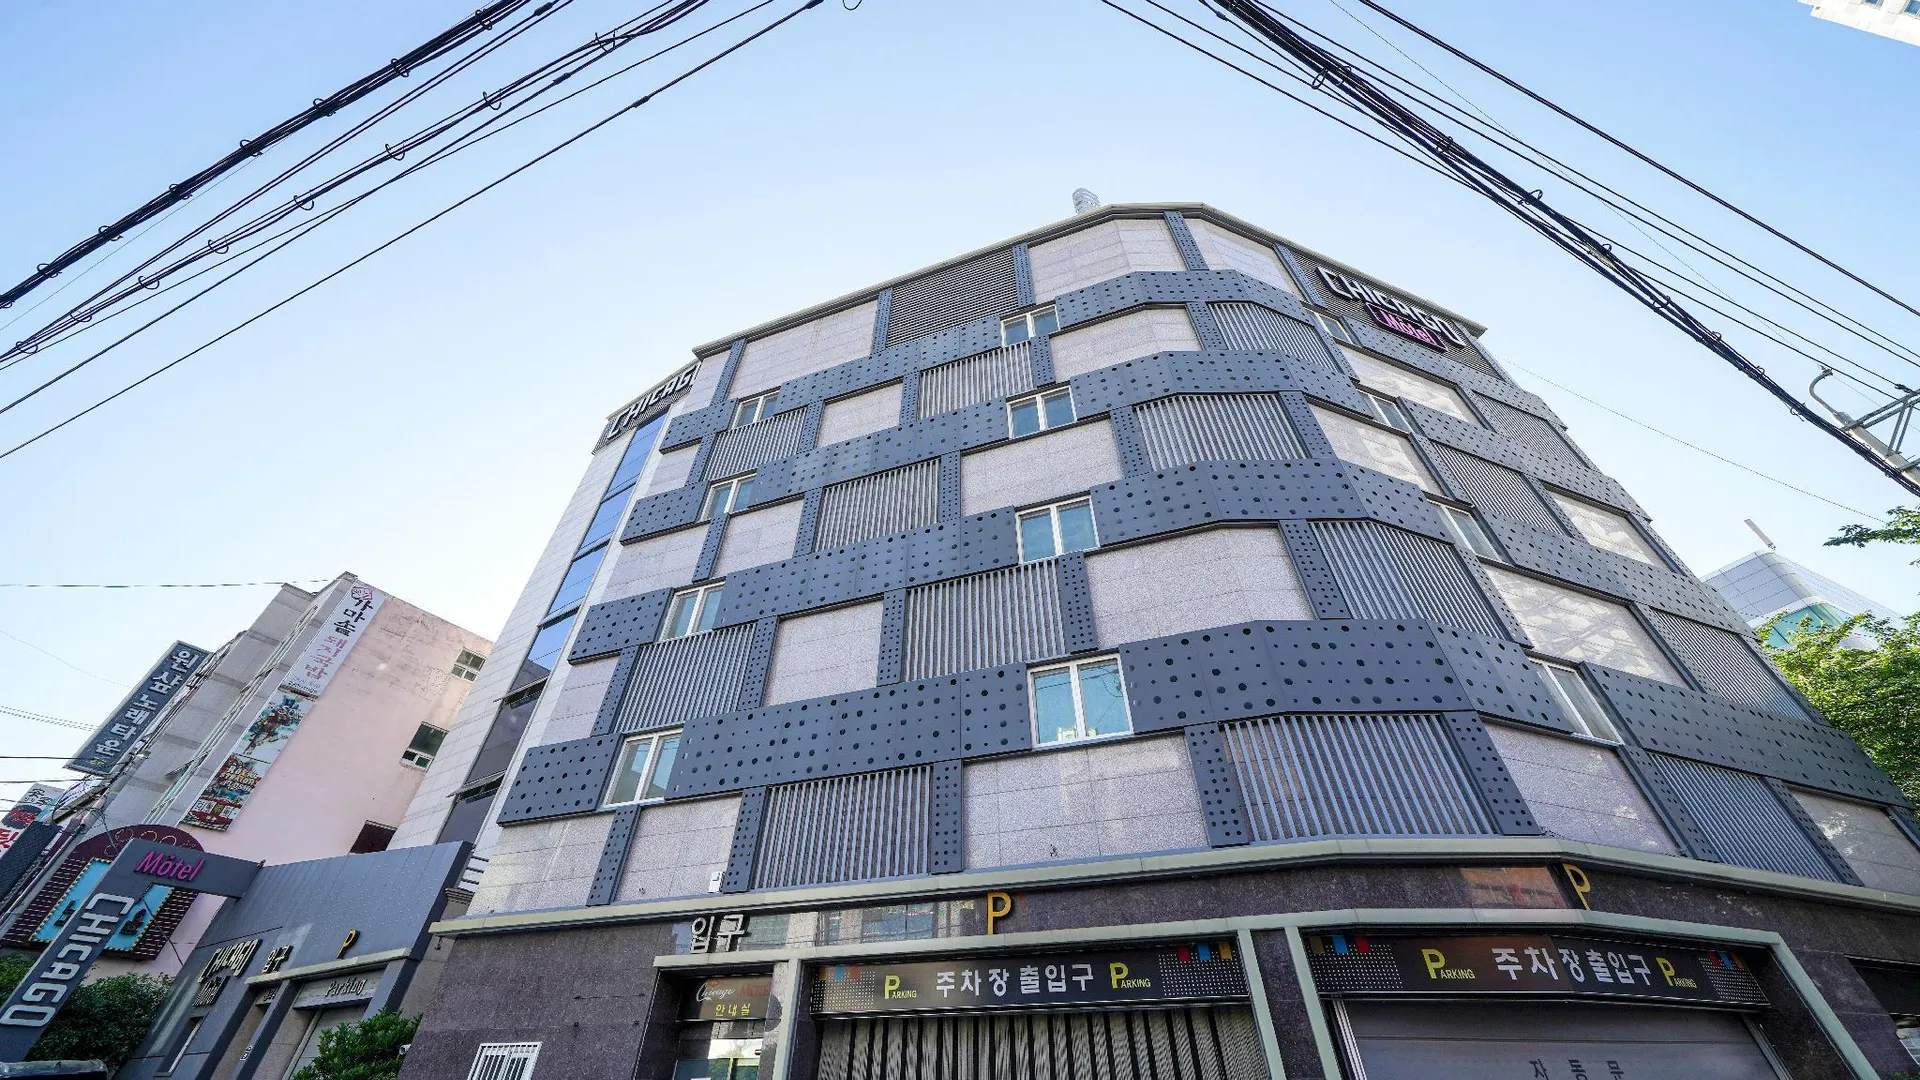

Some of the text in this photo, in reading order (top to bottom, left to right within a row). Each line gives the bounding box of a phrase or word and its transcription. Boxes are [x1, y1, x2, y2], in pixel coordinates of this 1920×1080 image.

[1316, 266, 1468, 348] CHICAGO
[607, 363, 701, 440] CHICAG
[1562, 863, 1591, 911] P
[690, 914, 745, 954] 입구
[987, 892, 1012, 936] P
[0, 892, 135, 1028] CHICAGO
[198, 938, 260, 983] CHICAGO
[262, 944, 292, 974] 입구
[336, 929, 358, 959] P
[325, 977, 368, 998] Parking
